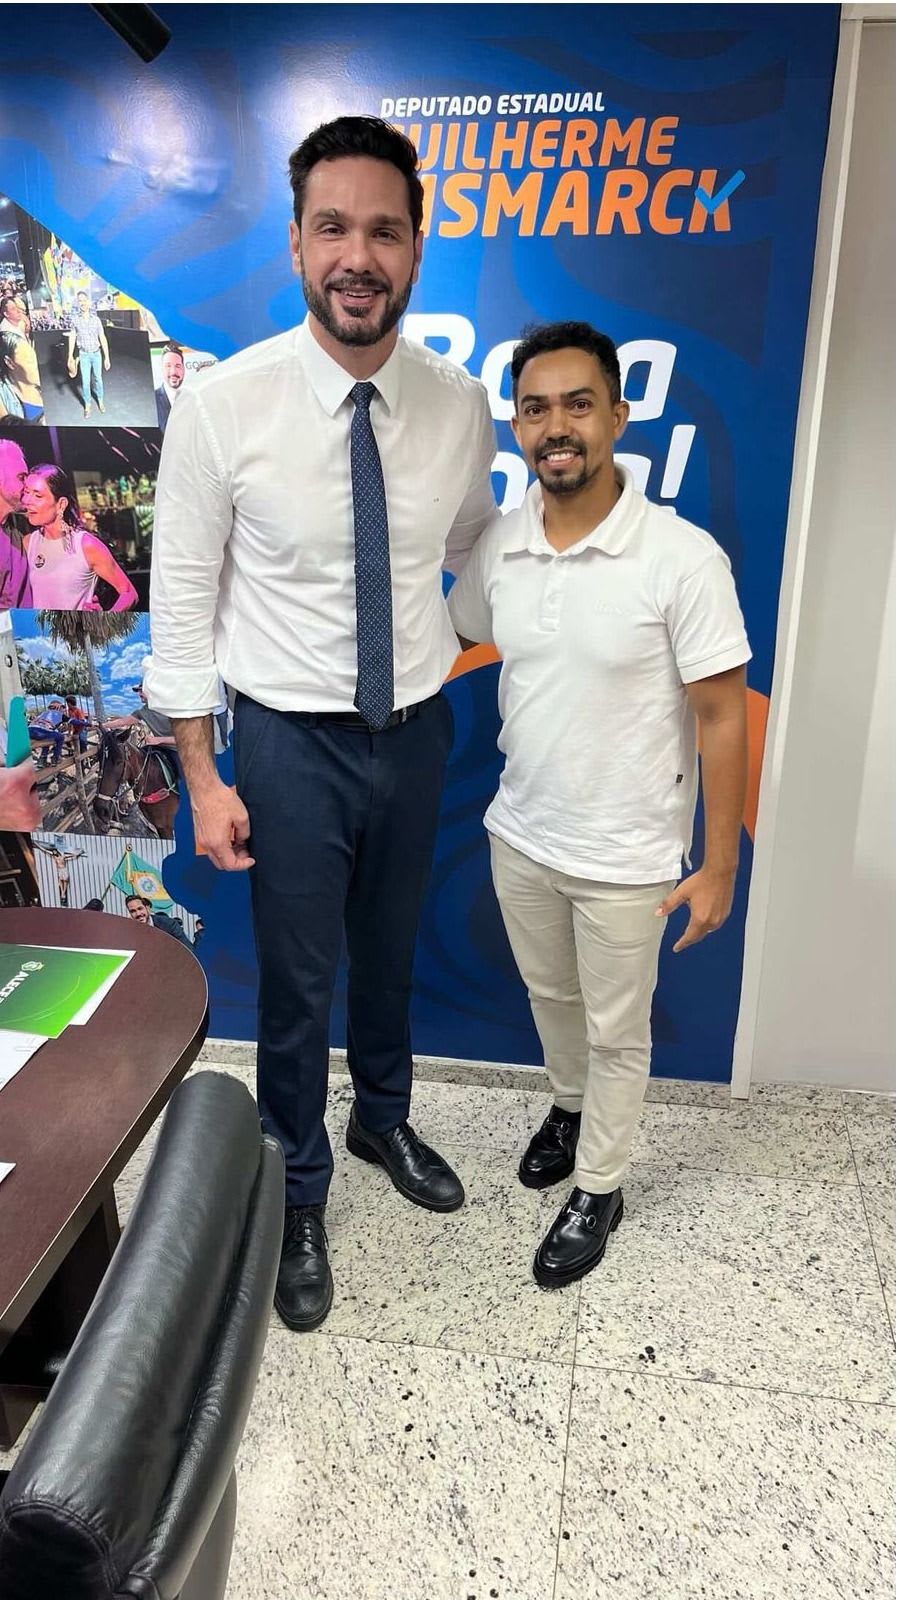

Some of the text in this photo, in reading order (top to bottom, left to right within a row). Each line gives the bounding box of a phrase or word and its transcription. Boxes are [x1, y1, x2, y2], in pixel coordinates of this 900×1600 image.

[380, 92, 605, 119] DEPUTADO ESTADUAL
[388, 116, 680, 171] UILHERME
[419, 169, 745, 238] ISMARCK
